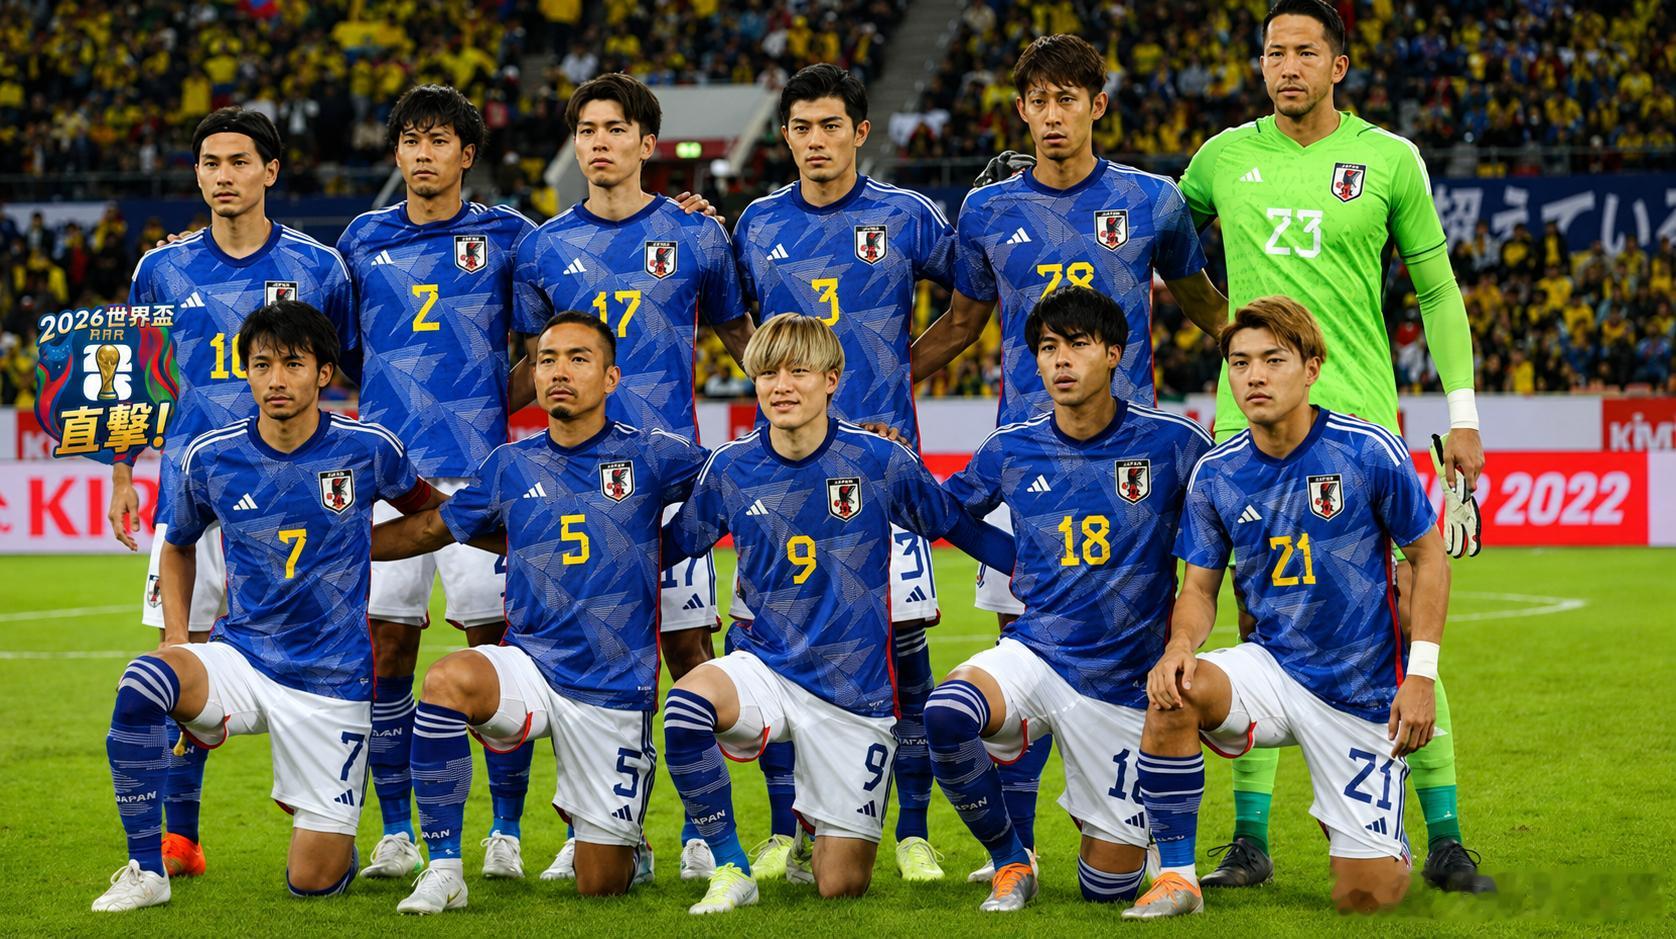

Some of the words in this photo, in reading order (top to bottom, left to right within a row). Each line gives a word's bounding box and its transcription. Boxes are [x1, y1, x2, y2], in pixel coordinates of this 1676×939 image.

[1264, 207, 1323, 259] 23
[412, 283, 440, 332] 2
[592, 289, 642, 338] 17
[811, 277, 840, 326] 3
[1494, 470, 1632, 526] 2022
[278, 528, 307, 579] 7
[560, 513, 590, 566] 5
[787, 535, 817, 585] 9
[894, 531, 924, 581] 3
[1058, 514, 1111, 567] 18
[1269, 532, 1317, 587] 21
[340, 731, 365, 781] 7
[613, 747, 643, 799] 5
[863, 742, 889, 792] 9
[1343, 747, 1396, 811] 21
